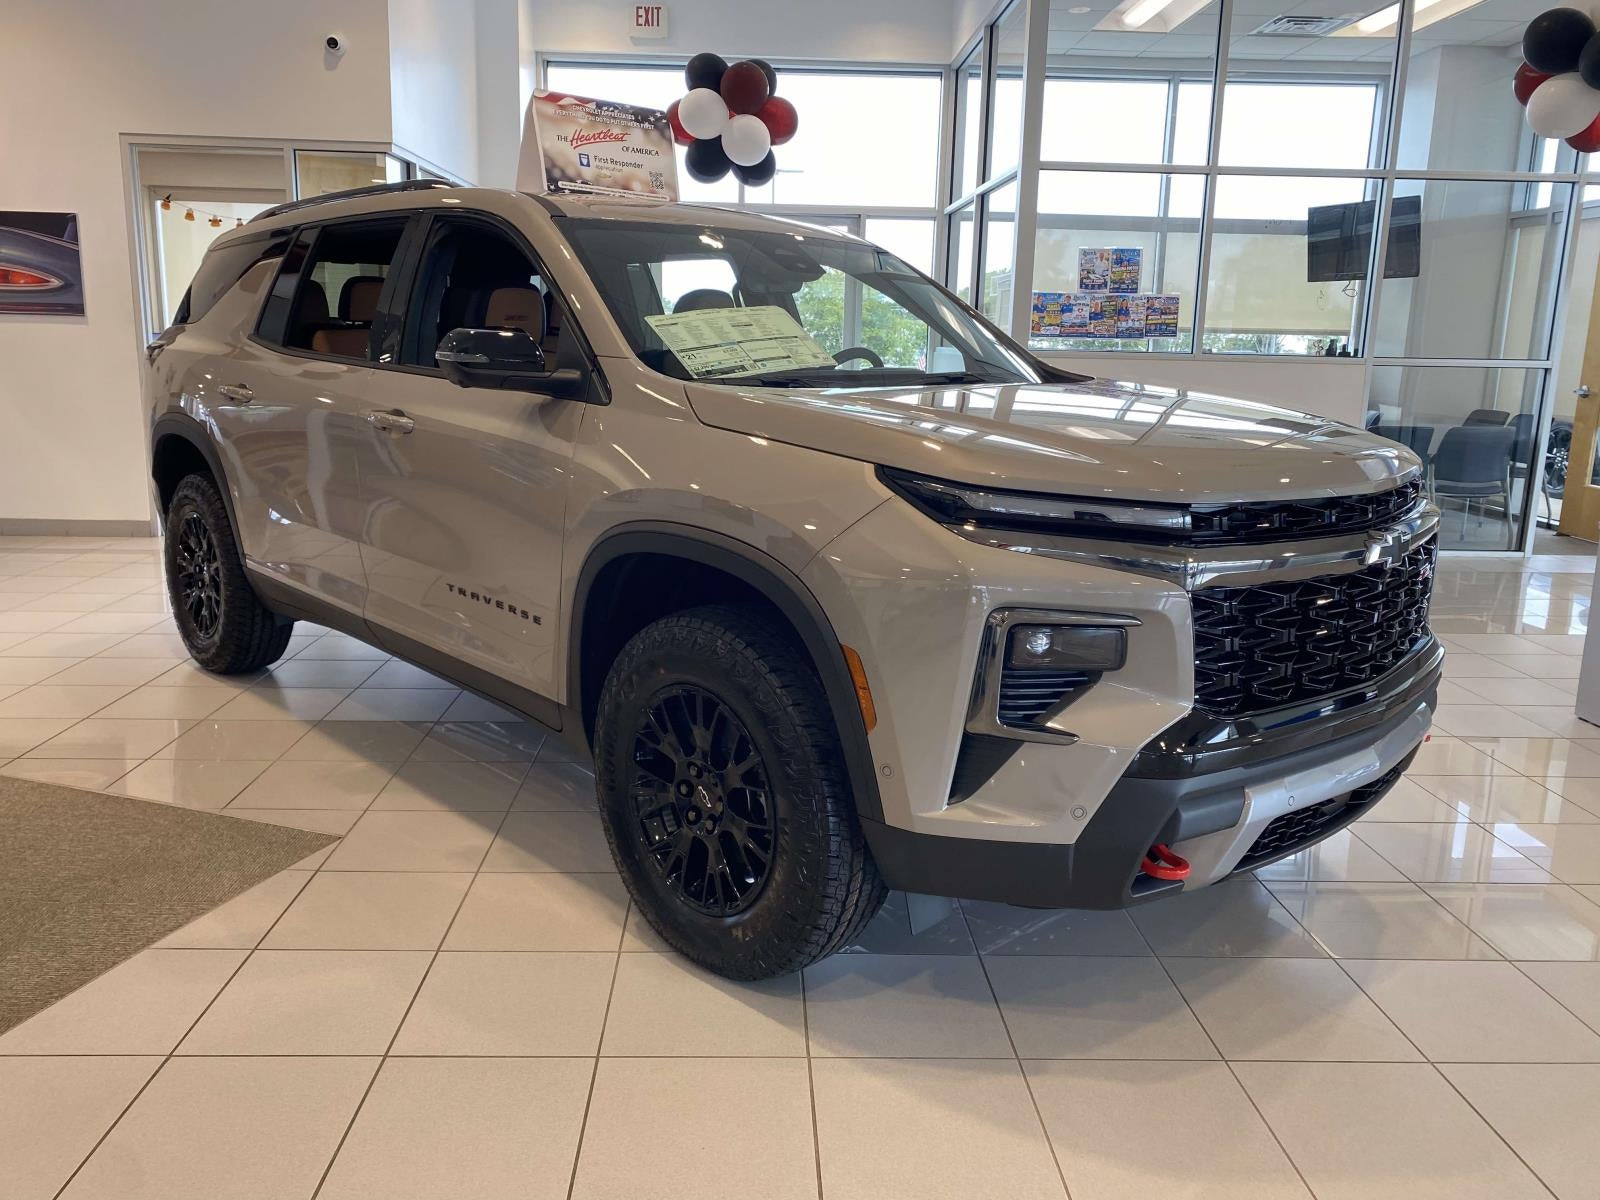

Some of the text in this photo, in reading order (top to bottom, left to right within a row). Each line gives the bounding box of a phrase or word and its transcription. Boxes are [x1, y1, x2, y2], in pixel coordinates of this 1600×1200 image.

[636, 6, 661, 27] EXIT
[601, 109, 635, 120] APPRECIATES
[556, 128, 631, 149] THE Heartbeat
[621, 145, 660, 157] OF AMERICA
[594, 155, 643, 169] First Responder
[446, 583, 542, 626] TRAVERSE
